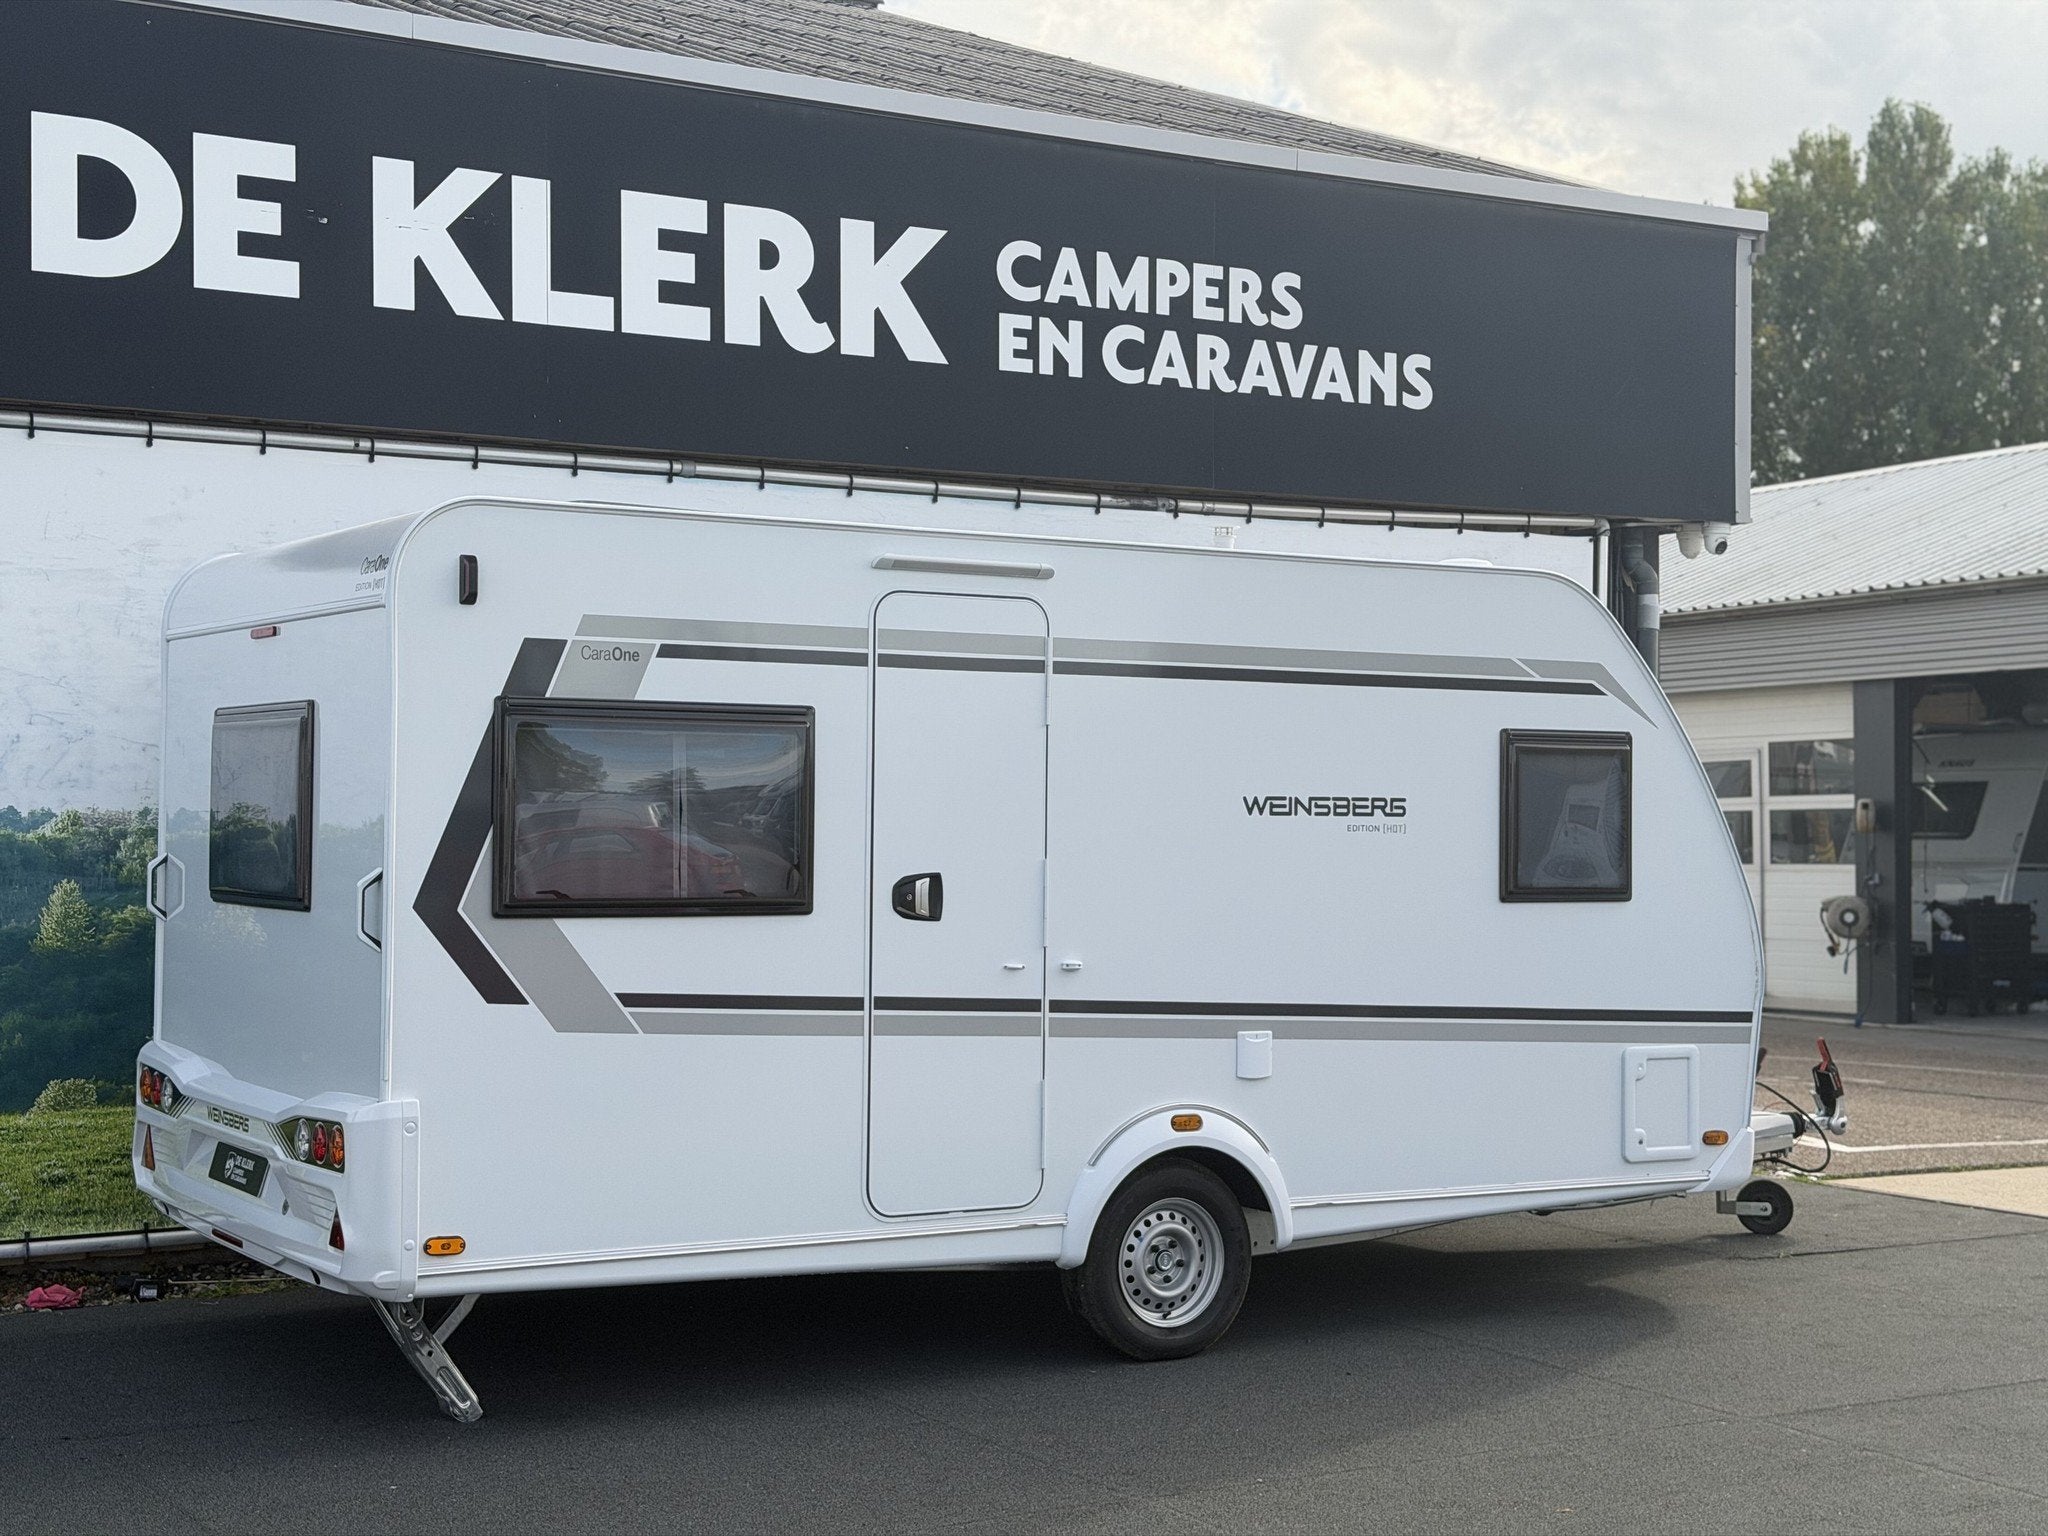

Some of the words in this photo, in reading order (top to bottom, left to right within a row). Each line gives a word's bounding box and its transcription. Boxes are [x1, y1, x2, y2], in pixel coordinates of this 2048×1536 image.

[31, 111, 300, 299] DE
[373, 156, 949, 364] KLERK
[996, 240, 1303, 330] CAMPERS
[999, 312, 1083, 378] EN
[1102, 324, 1433, 410] CARAVANS
[581, 645, 640, 662] CaraOne
[1242, 796, 1407, 818] WEINSBERG
[1346, 824, 1381, 833] EDITION
[206, 1105, 250, 1133] WEINSBERG
